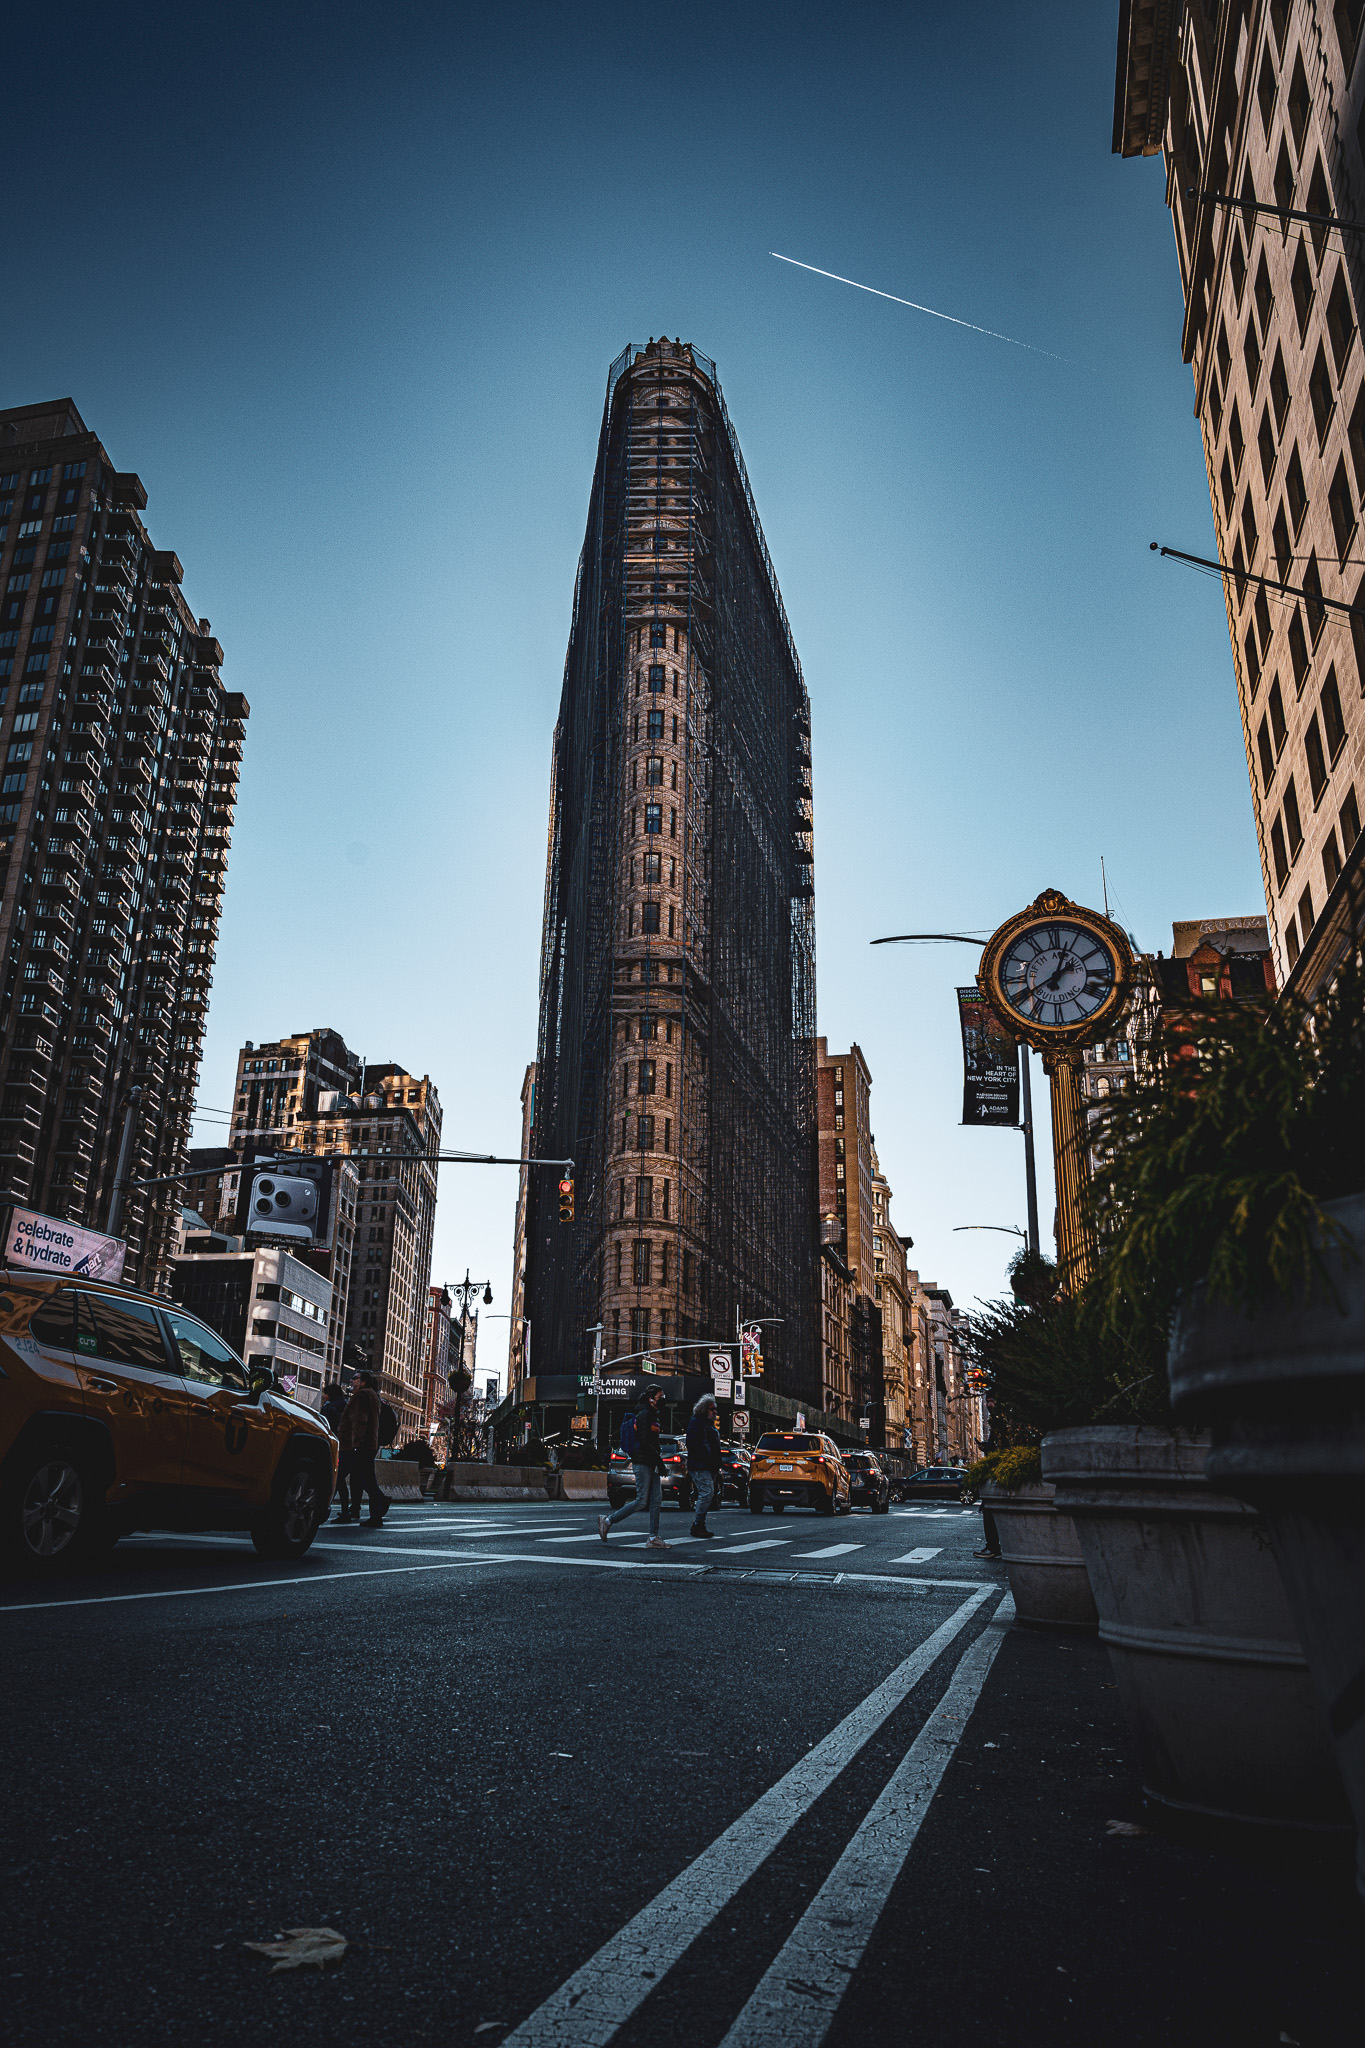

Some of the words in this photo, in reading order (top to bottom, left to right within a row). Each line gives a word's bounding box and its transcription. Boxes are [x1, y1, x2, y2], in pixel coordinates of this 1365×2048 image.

[1029, 956, 1048, 978] FIFTH
[1036, 985, 1081, 1002] BUILDING
[18, 1220, 74, 1248] celebrate
[13, 1237, 24, 1254] &
[25, 1239, 72, 1267] hydrate
[79, 1337, 96, 1347] curb
